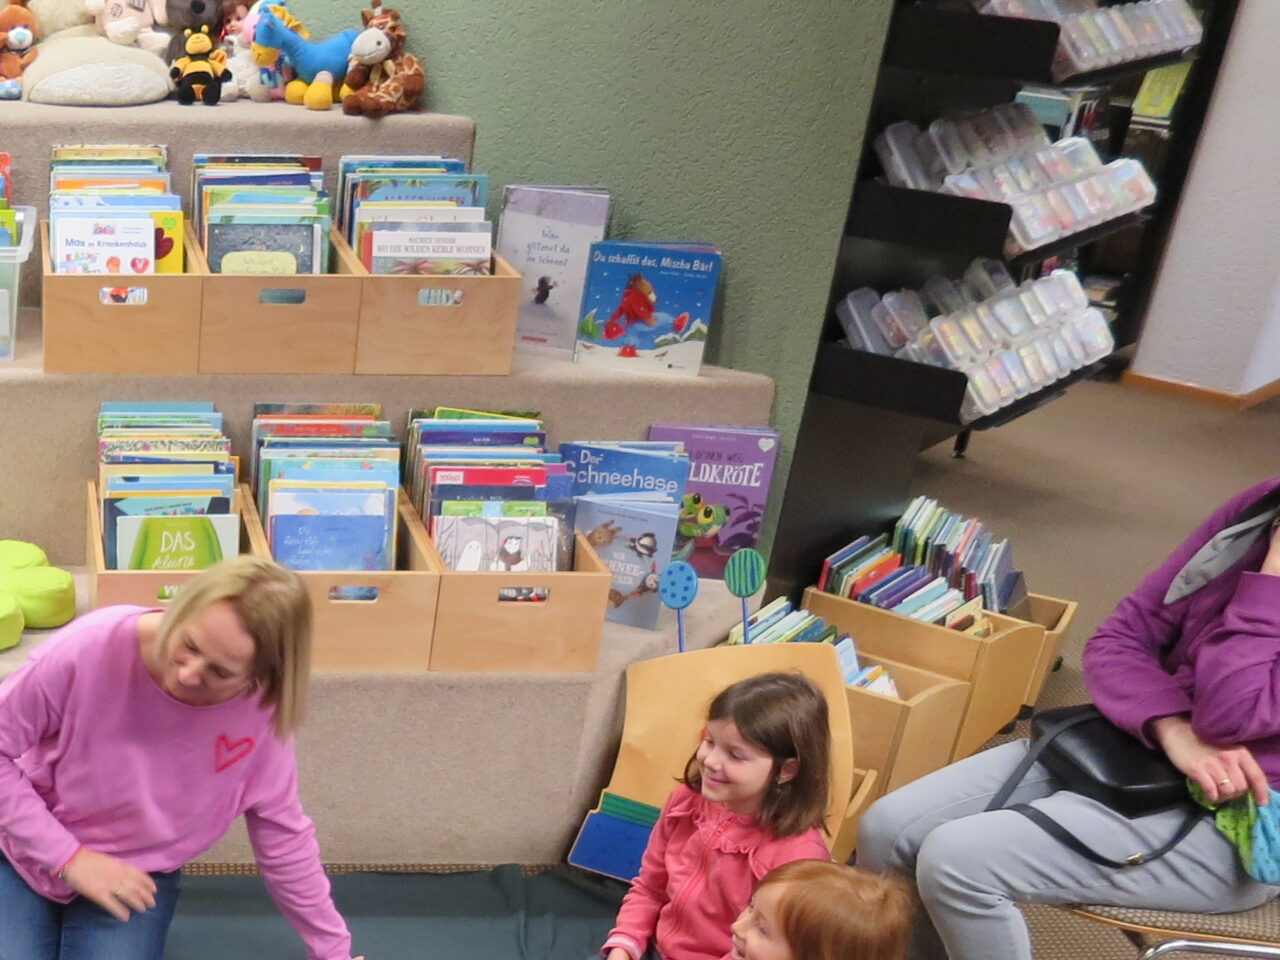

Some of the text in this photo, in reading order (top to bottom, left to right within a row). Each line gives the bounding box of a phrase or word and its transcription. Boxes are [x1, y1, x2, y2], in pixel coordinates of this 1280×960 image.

[64, 238, 85, 247] Max
[96, 239, 147, 248] Krankenhaus
[593, 250, 606, 262] Du
[607, 253, 639, 265] schaffst
[660, 257, 691, 270] Mischa
[580, 450, 604, 465] Der
[565, 460, 678, 493] Schneehase
[688, 461, 764, 487] LDKRÖTE
[160, 531, 196, 553] DAS
